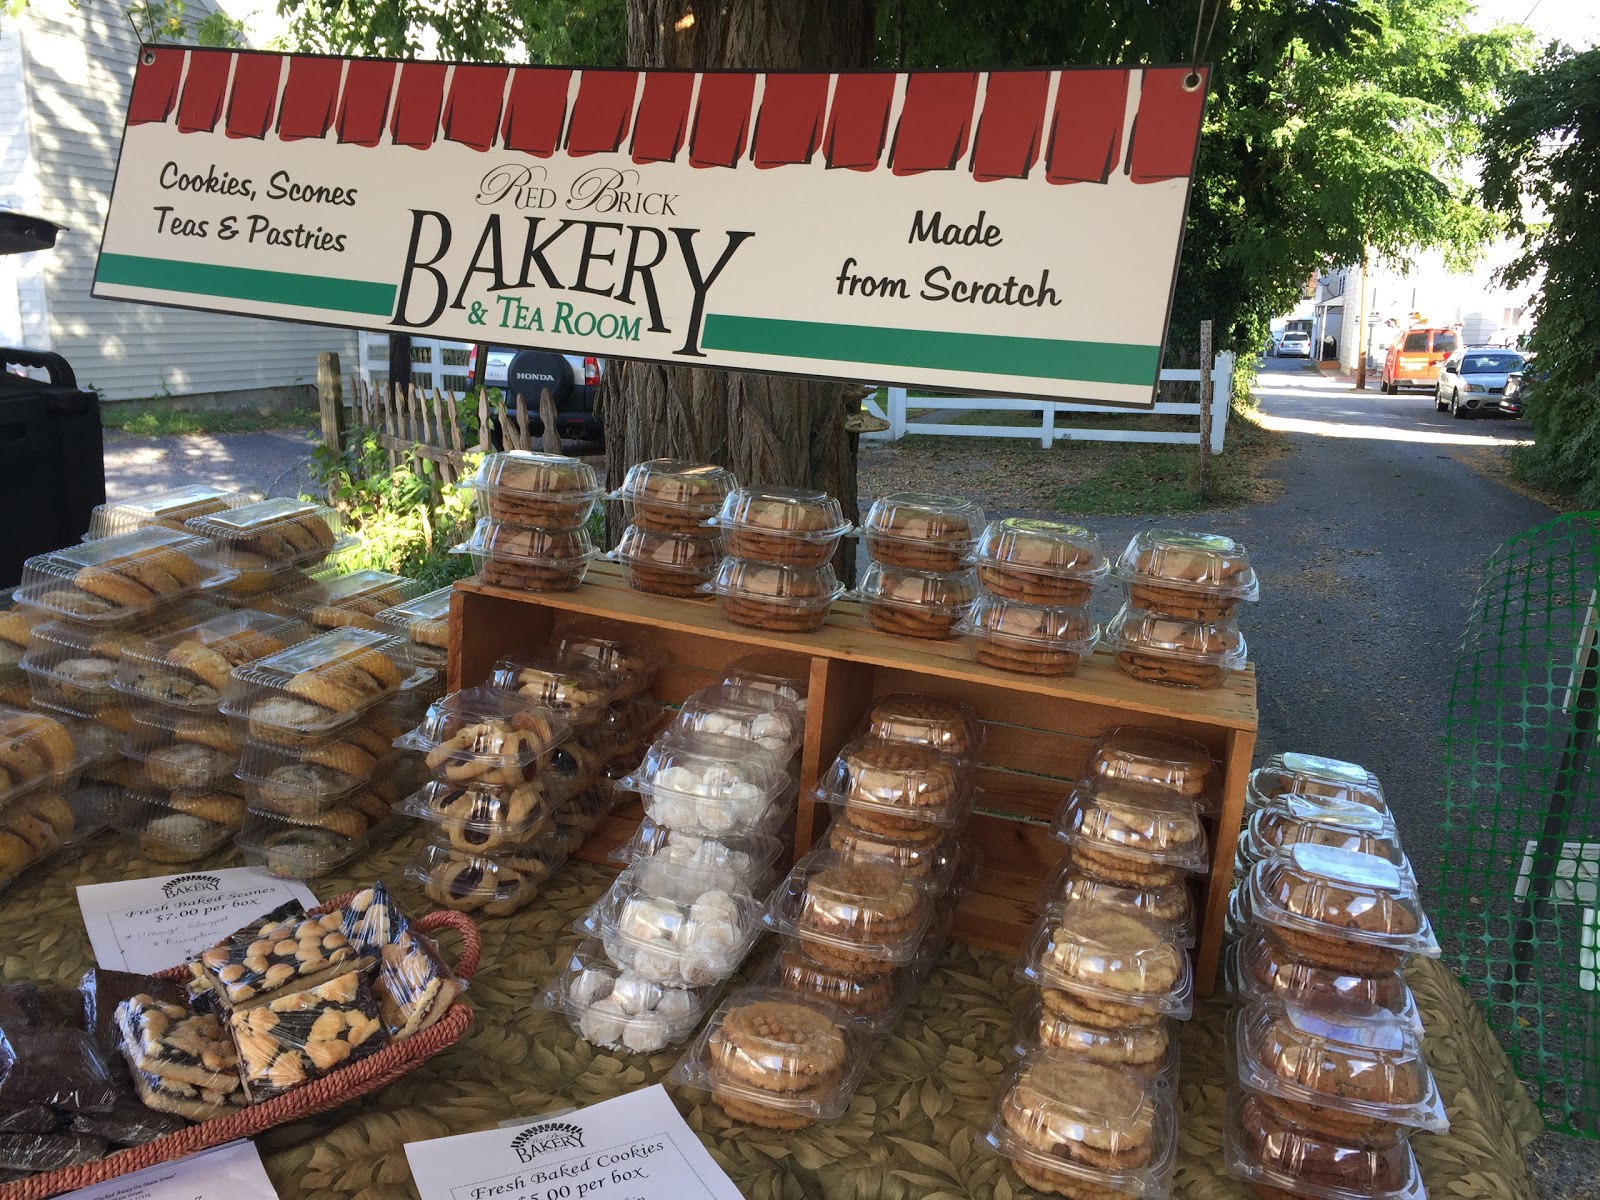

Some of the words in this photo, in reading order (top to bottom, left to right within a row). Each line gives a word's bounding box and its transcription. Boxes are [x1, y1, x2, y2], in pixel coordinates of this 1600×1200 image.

[159, 160, 257, 202] Cookies,
[266, 170, 358, 207] Scones
[153, 206, 209, 238] Teas
[217, 216, 240, 240] &
[246, 214, 347, 252] Pastries
[908, 209, 1003, 247] Made
[386, 208, 756, 358] BAKERY
[836, 257, 910, 299] from
[920, 265, 1062, 307] Scratch
[467, 300, 489, 326] &
[496, 294, 545, 332] TEA
[550, 301, 643, 342] ROOM
[516, 372, 554, 381] HONDA
[126, 904, 168, 917] Fresh
[173, 894, 224, 909] Baked
[227, 887, 276, 901] Scones
[165, 881, 219, 898] BAKERY
[155, 908, 199, 923] $7.00
[203, 903, 228, 916] per
[232, 897, 262, 908] box
[514, 1131, 587, 1164] BAKERY
[470, 1176, 526, 1200] Fresh
[530, 1157, 592, 1185] Baked
[596, 1142, 665, 1168] Cookies
[576, 1176, 607, 1198] per
[611, 1167, 650, 1184] box
